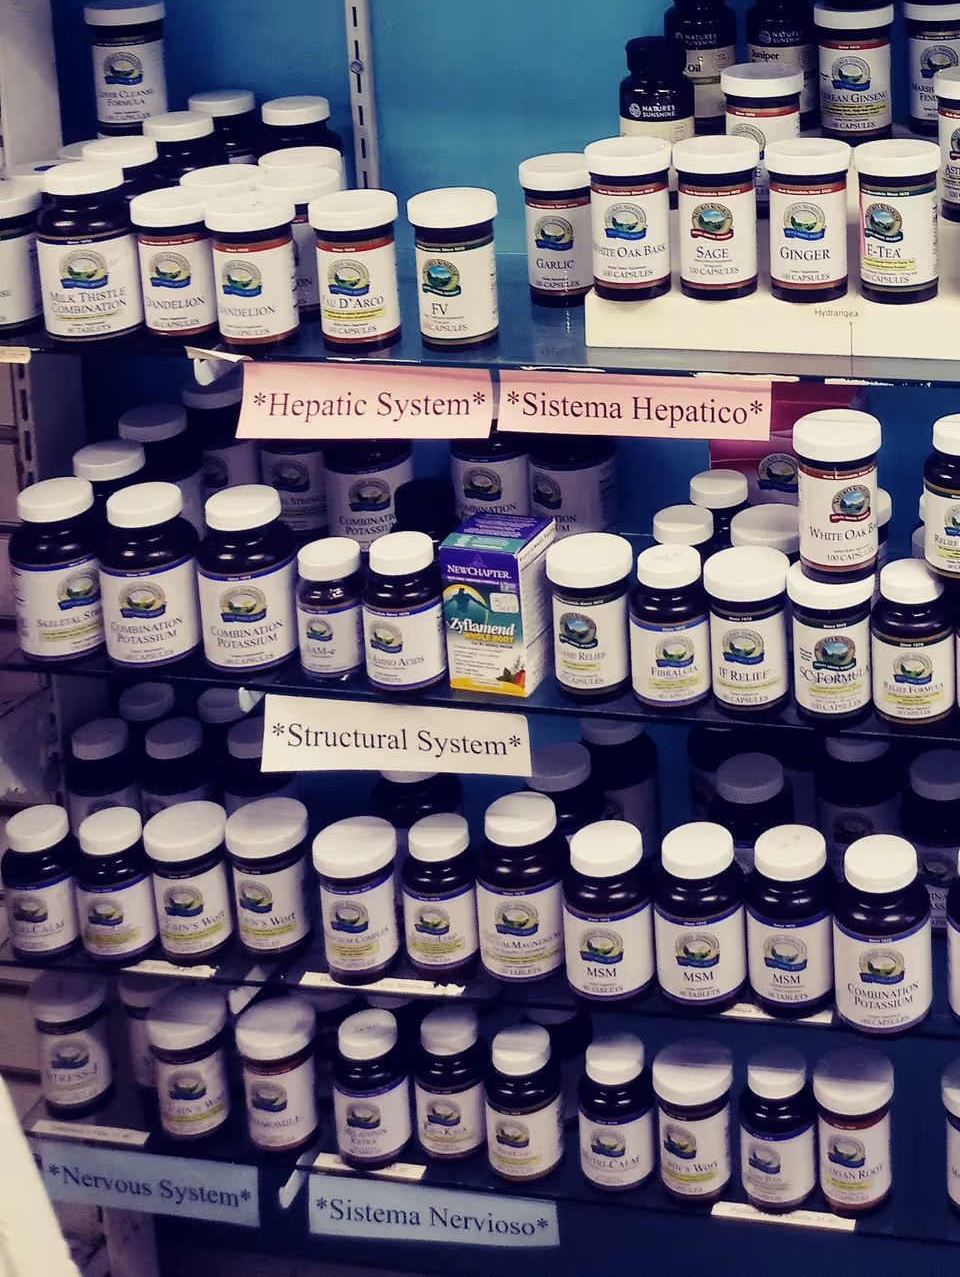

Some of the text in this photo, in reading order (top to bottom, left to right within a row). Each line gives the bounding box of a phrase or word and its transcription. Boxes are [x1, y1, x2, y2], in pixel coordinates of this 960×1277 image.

[696, 246, 729, 258] SAGE
[780, 247, 830, 260] GINGER
[536, 258, 574, 270] GARLIC
[431, 303, 449, 315] FV
[814, 308, 859, 319] Hydrangea
[450, 617, 516, 636] Zyflamend
